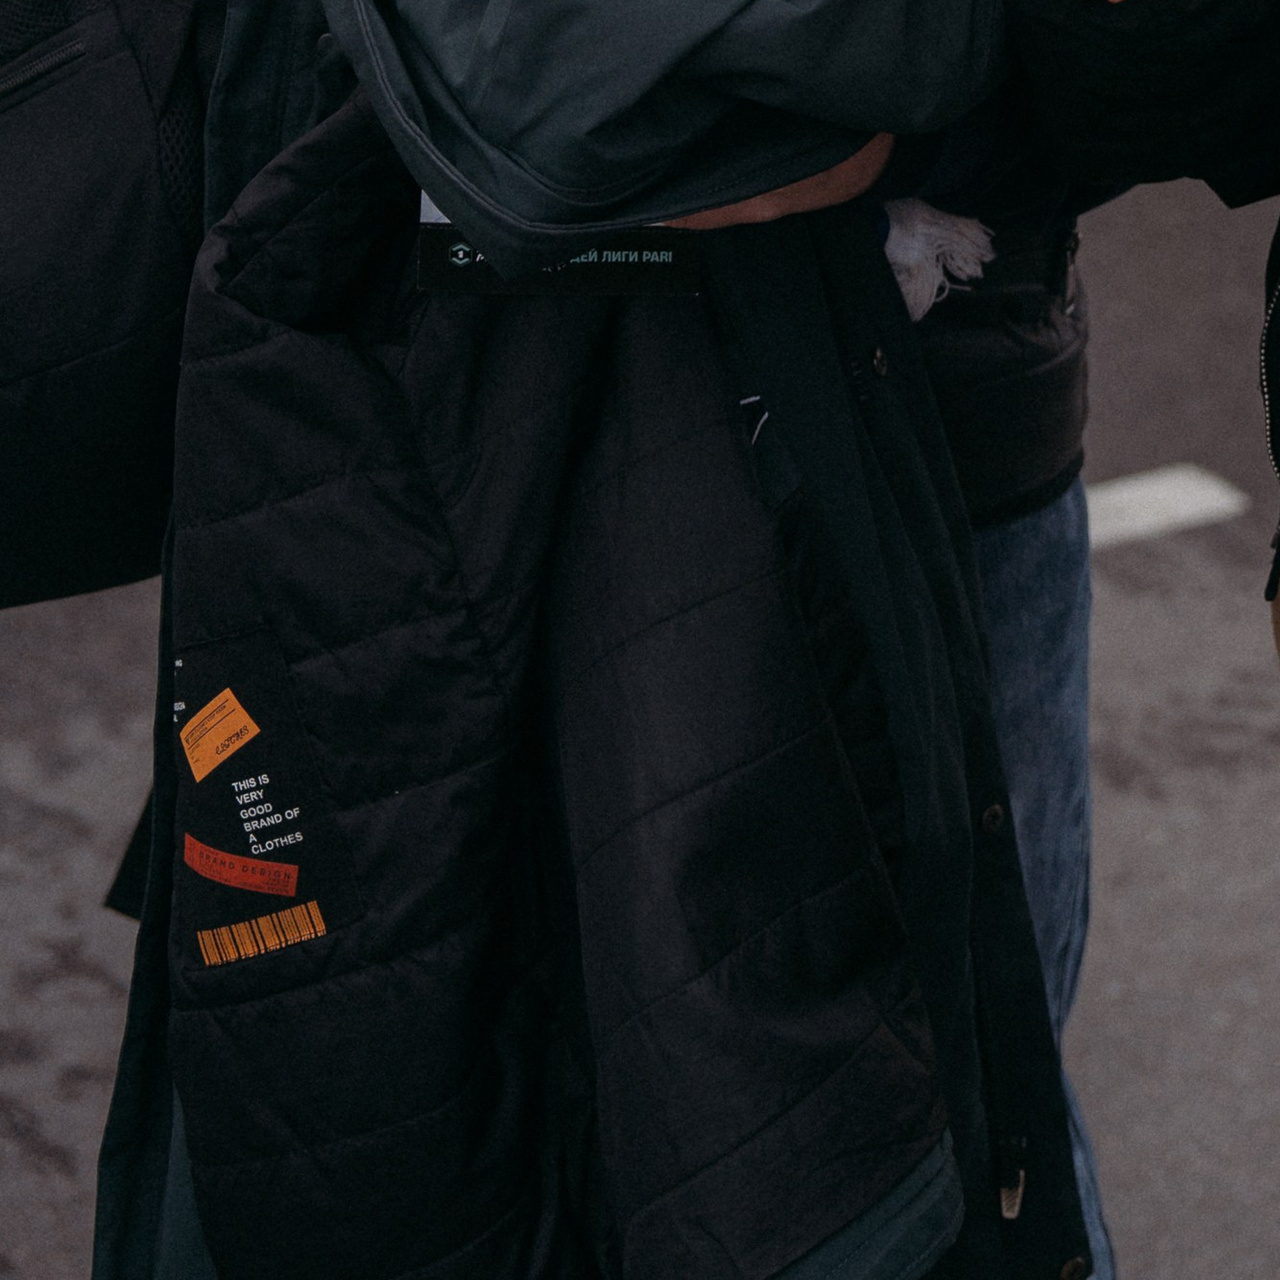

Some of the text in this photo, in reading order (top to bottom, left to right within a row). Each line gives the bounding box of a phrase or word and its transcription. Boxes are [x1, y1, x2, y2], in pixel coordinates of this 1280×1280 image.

[601, 250, 639, 263] ЛИГИ
[642, 250, 673, 263] PARI
[231, 774, 270, 792] THIS IS
[235, 789, 264, 805] VERY
[240, 803, 273, 819] GOOD
[243, 807, 300, 832] BRAND OF
[249, 833, 258, 844] A
[251, 831, 304, 855] CLOTHES
